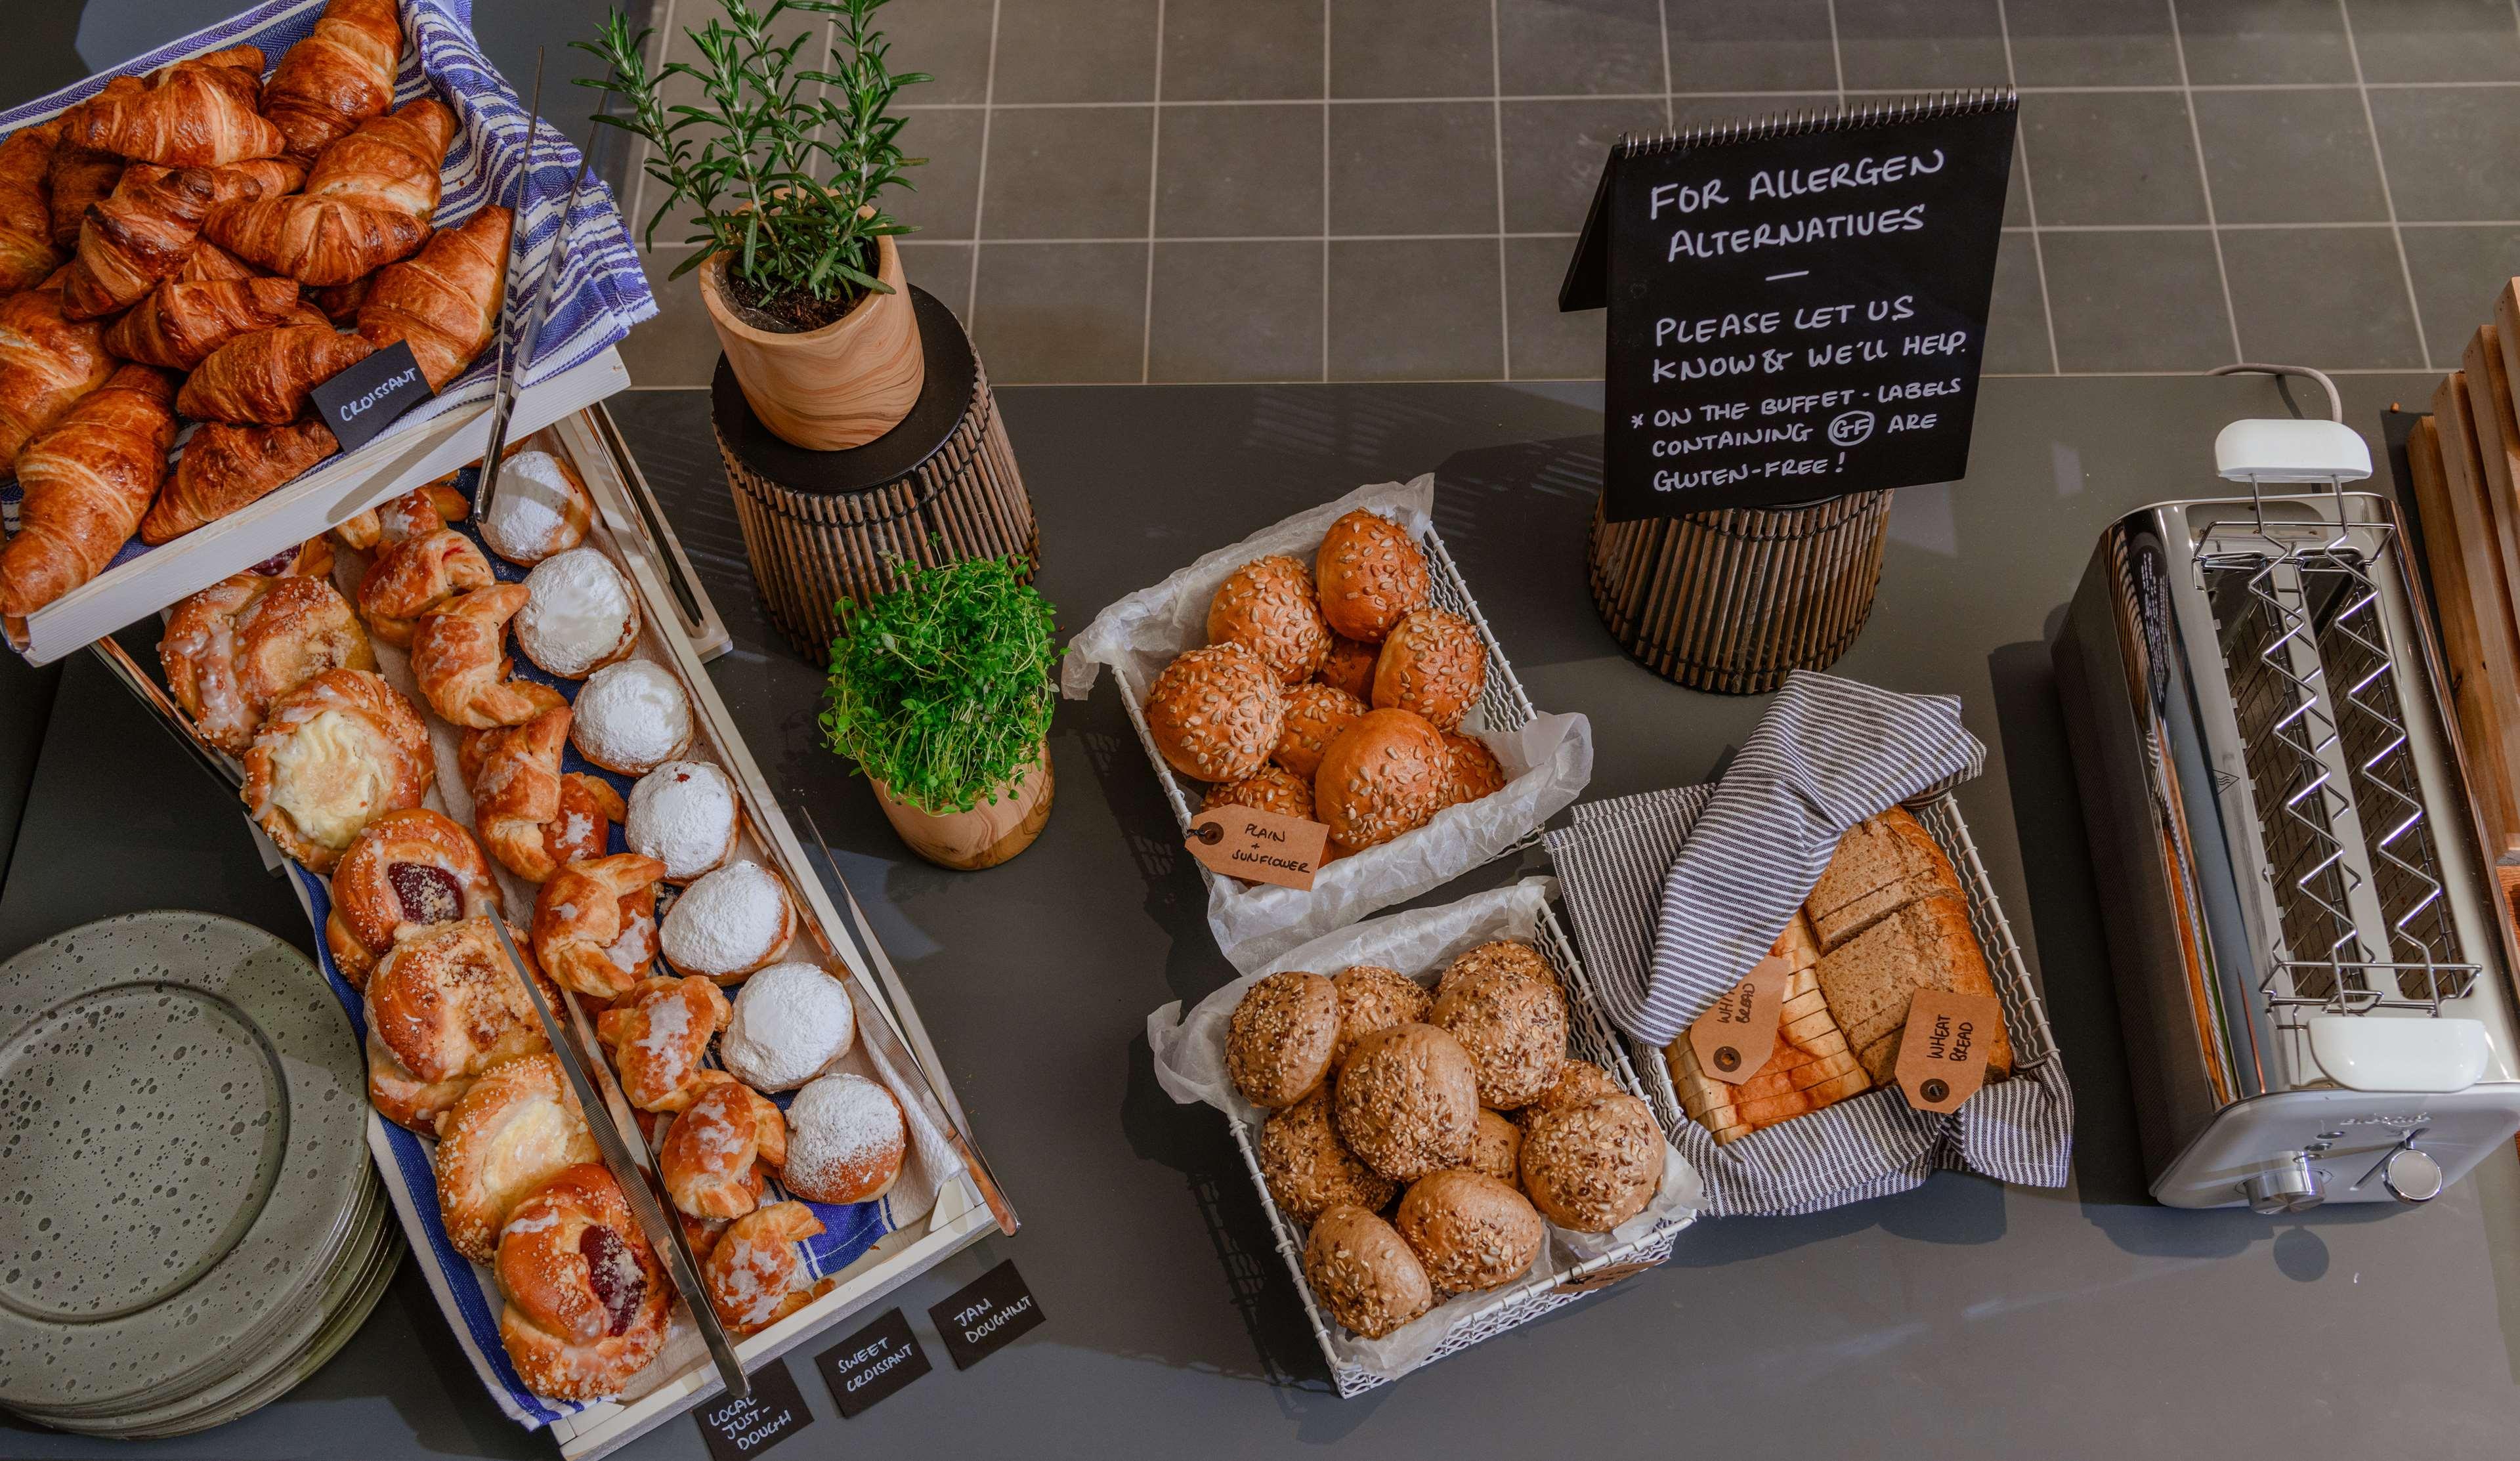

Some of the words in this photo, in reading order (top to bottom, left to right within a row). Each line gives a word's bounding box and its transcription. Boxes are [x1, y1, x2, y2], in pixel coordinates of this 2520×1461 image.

[1650, 179, 1729, 220] FOR
[1749, 148, 1944, 201] ALLERGEN
[1668, 203, 1925, 263] ALTERNATIVES
[1656, 310, 1781, 347] PLEASE
[1795, 305, 1856, 329] LET
[1868, 295, 1915, 321] US
[1653, 354, 1755, 383] KNOW
[1808, 341, 1888, 368] WE'LL
[1902, 331, 1967, 356] HELP.
[340, 368, 416, 421] CROISSANT
[1654, 408, 1692, 427] ON
[1699, 403, 1750, 421] THE
[1761, 389, 1855, 415] BUFFET
[1878, 377, 1961, 403] LABELS
[1652, 423, 1814, 457] CONTAINING
[1832, 417, 1874, 439] GF
[1887, 413, 1938, 434] ARE
[1245, 823, 1285, 843] PLAIN
[1231, 849, 1310, 874] SUNFLOWER
[1735, 983, 1755, 1024] BREAD
[1927, 1014, 1951, 1059] WHEAT
[1949, 1022, 1973, 1061] BREAD
[954, 1298, 993, 1326] JAM
[965, 1296, 1031, 1343] DOUGHNUT
[838, 1337, 888, 1374] SWEET
[846, 1344, 913, 1392] CROISSANT
[709, 1397, 757, 1426] LOCAL
[737, 1410, 792, 1450] DOUGH
